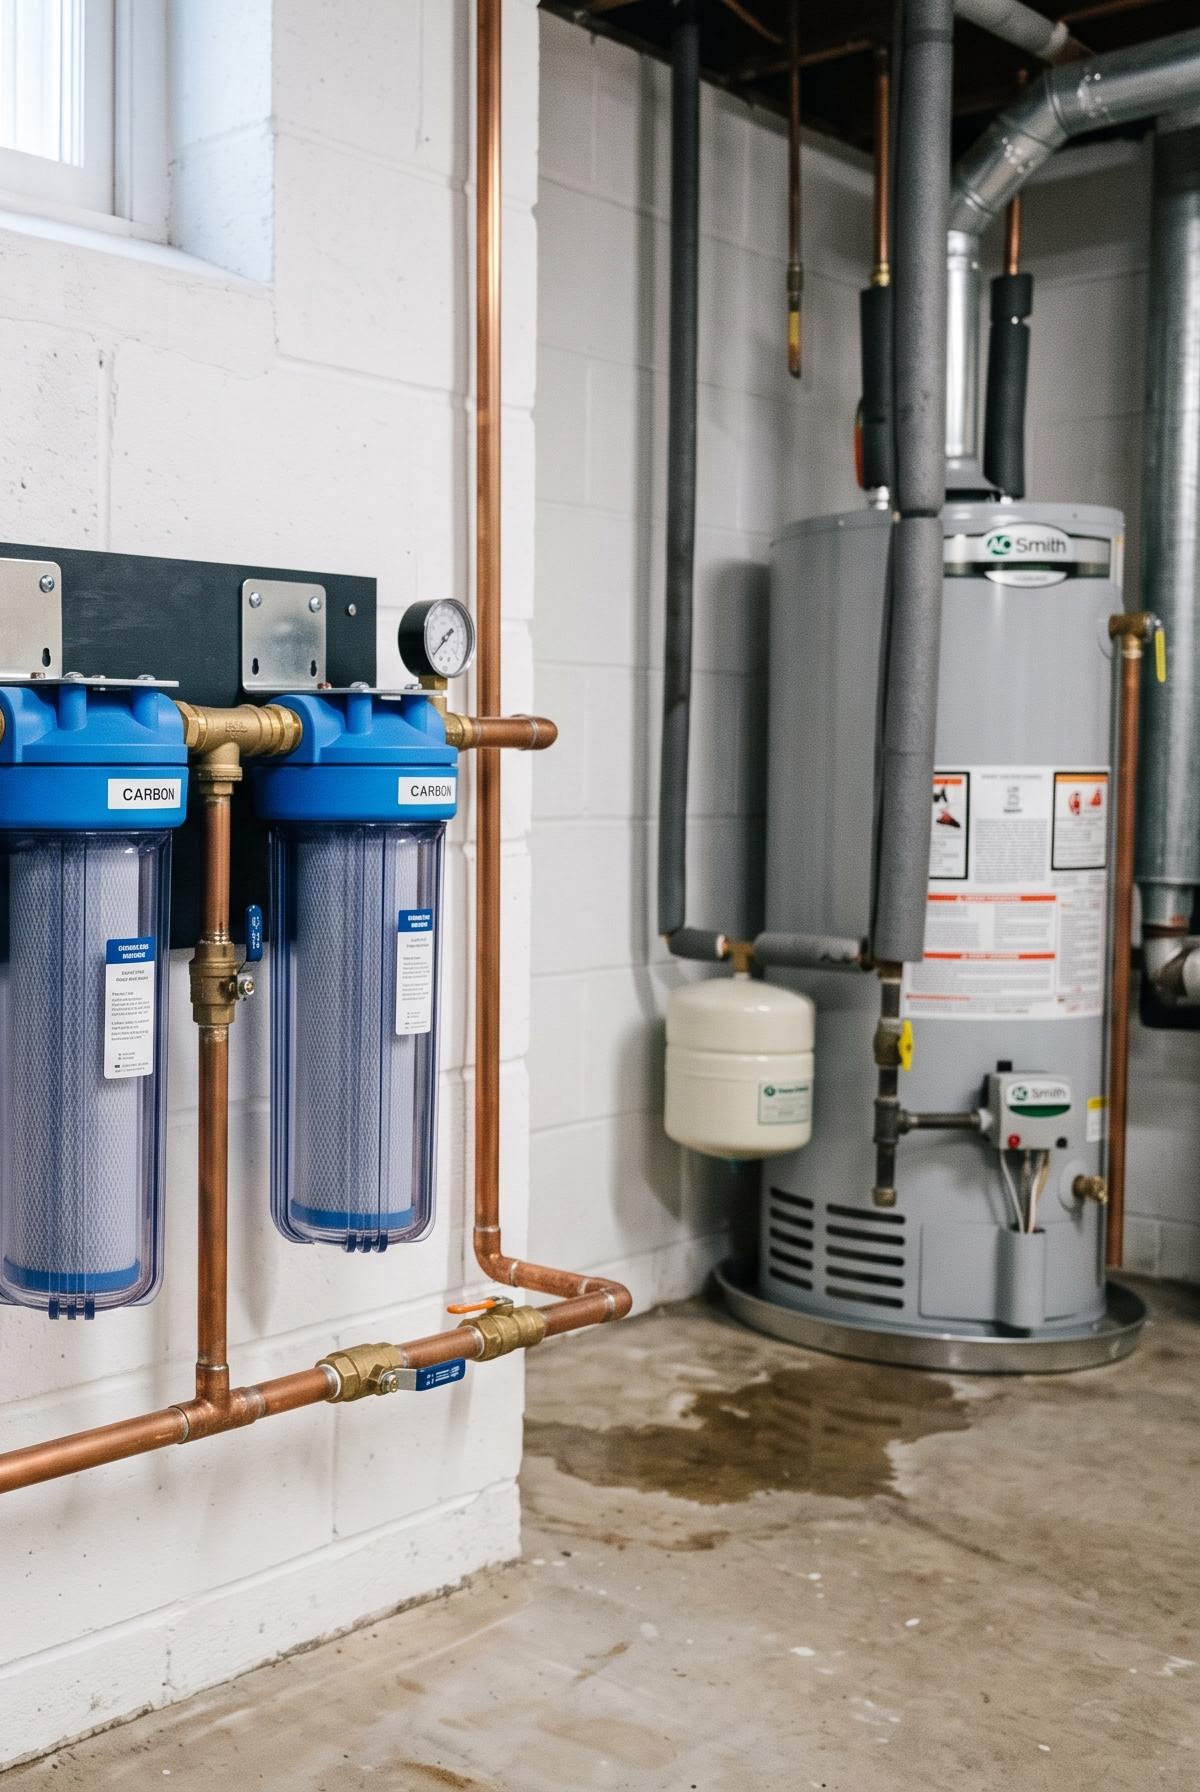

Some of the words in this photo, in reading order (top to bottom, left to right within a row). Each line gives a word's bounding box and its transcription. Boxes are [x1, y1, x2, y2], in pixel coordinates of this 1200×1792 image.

[1016, 537, 1066, 553] Smith
[122, 788, 175, 801] CARBON
[410, 785, 452, 797] CARBON
